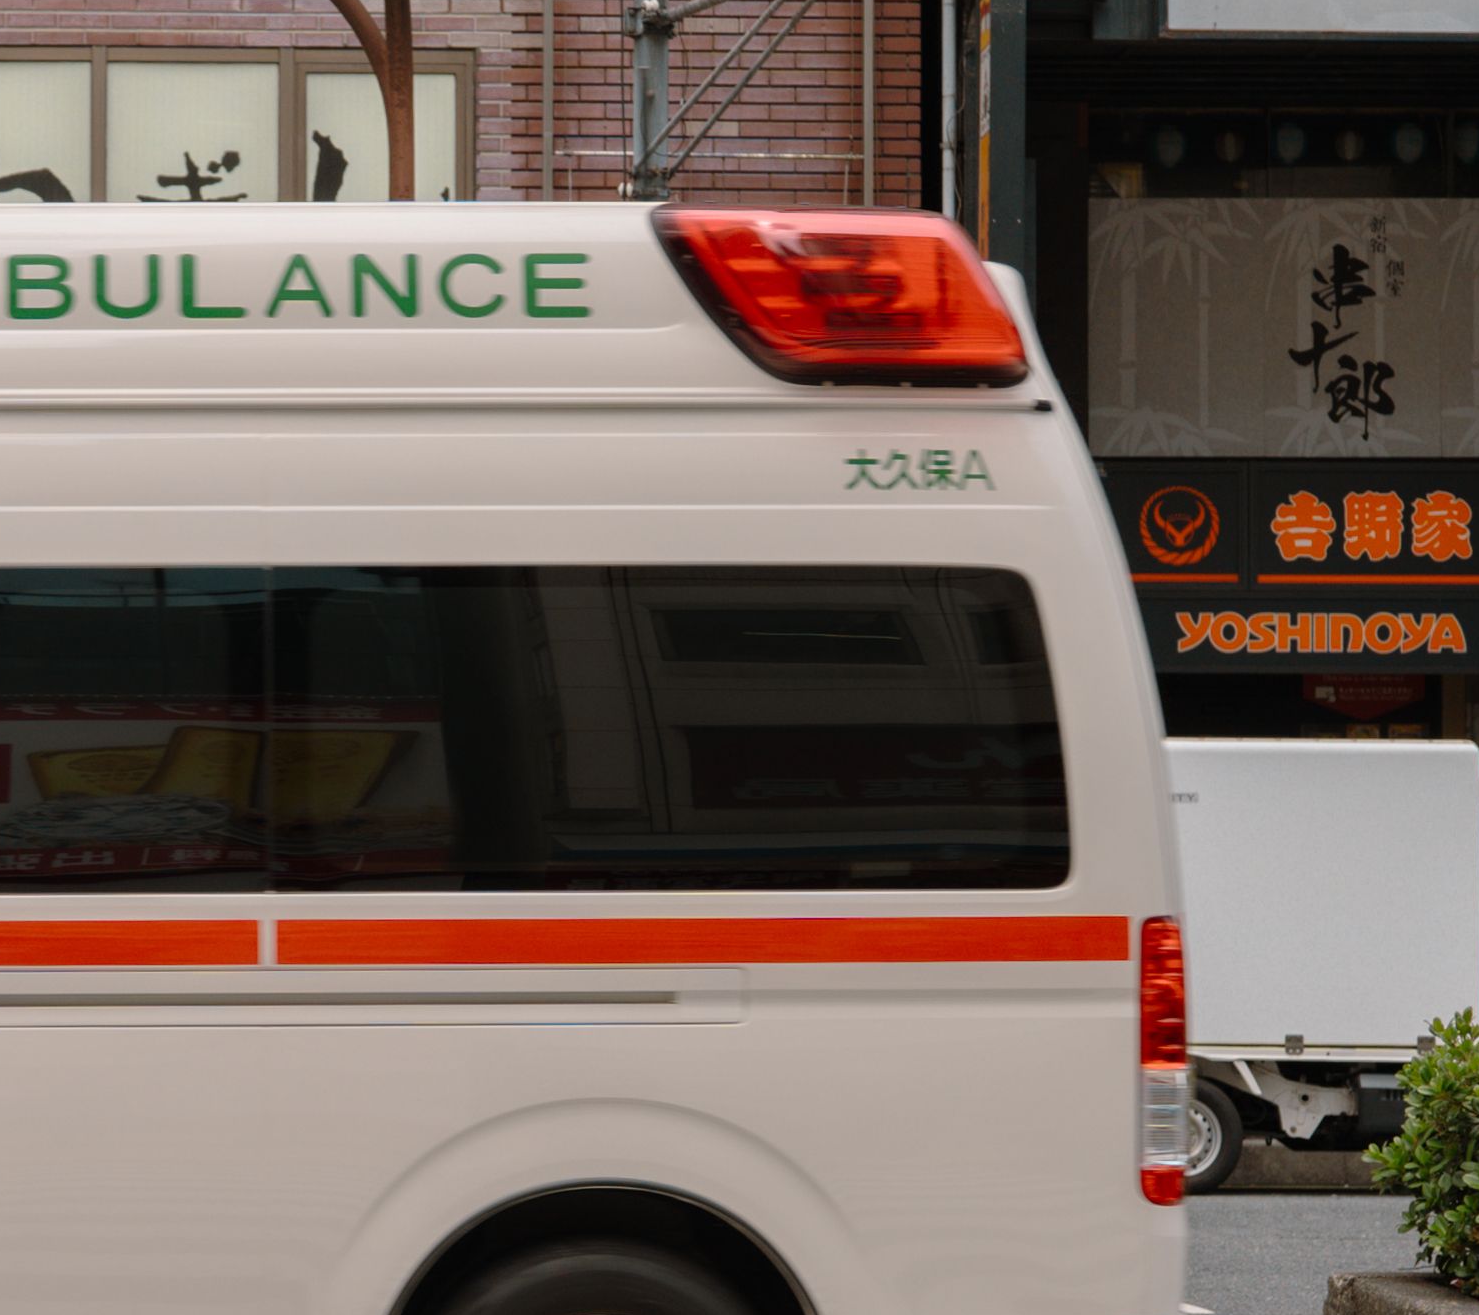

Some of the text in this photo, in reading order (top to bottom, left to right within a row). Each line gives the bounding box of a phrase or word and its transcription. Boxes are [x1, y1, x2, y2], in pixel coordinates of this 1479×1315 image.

[1270, 489, 1473, 562] 吉野家
[1176, 611, 1468, 655] YOSHINOYA
